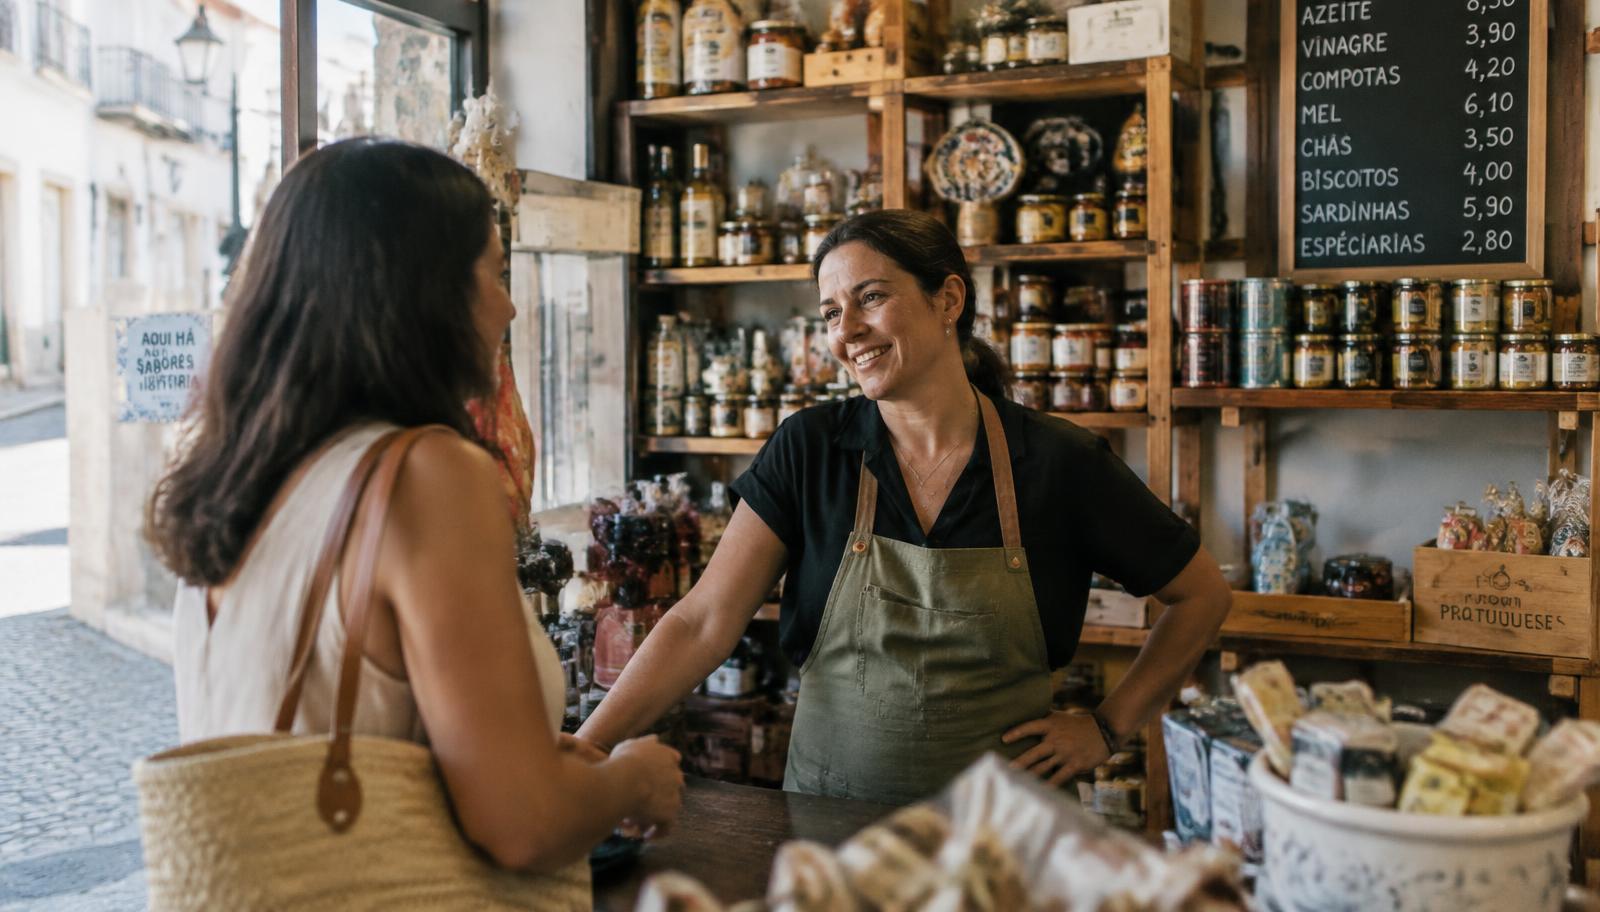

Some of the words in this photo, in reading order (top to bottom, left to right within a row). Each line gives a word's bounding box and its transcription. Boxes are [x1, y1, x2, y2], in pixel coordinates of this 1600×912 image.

[1302, 1, 1372, 26] AZEITE
[1301, 32, 1388, 58] VINAGRE
[1465, 21, 1516, 49] 3,90
[1300, 65, 1401, 92] COMPOTAS
[1464, 56, 1516, 83] 4,20
[1301, 103, 1342, 125] MEL
[1464, 91, 1515, 119] 6,10
[1464, 126, 1515, 152] 3,50
[1301, 167, 1399, 192] BISCOITOS
[1463, 160, 1514, 186] 4,00
[1301, 199, 1411, 224] SARDINHAS
[1463, 195, 1514, 221] 5,90
[1462, 230, 1513, 255] 2,80
